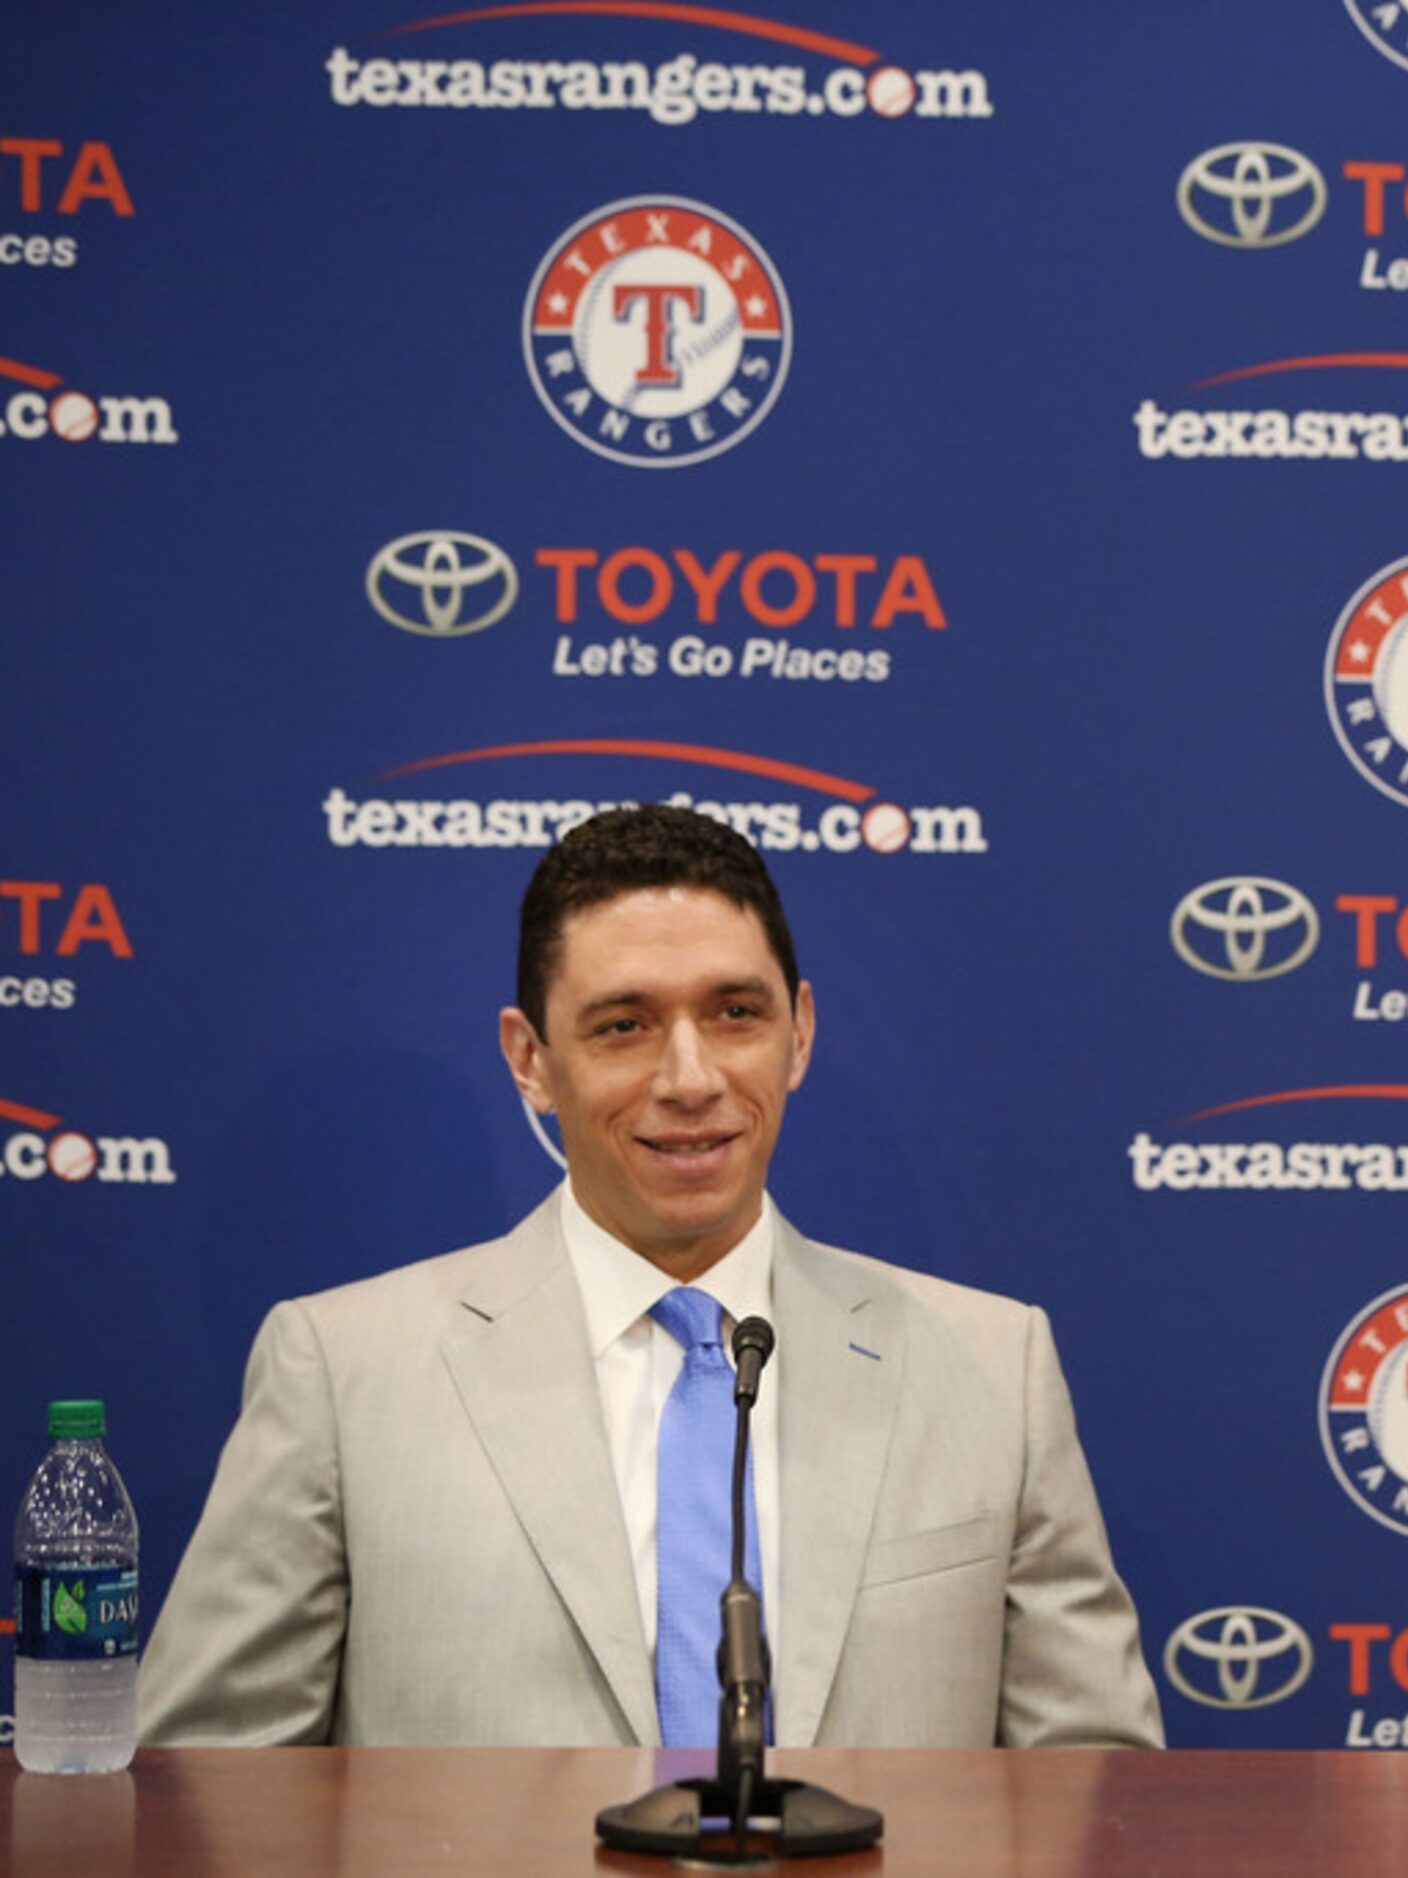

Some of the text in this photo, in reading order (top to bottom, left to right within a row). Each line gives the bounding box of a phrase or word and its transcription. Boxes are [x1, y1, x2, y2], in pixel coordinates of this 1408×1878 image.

[326, 48, 993, 125] texasrangers.com
[563, 214, 750, 282] TEXAS
[545, 350, 772, 451] RANGERS
[536, 547, 946, 629] TOYOTA
[553, 635, 892, 682] Let's Go Places
